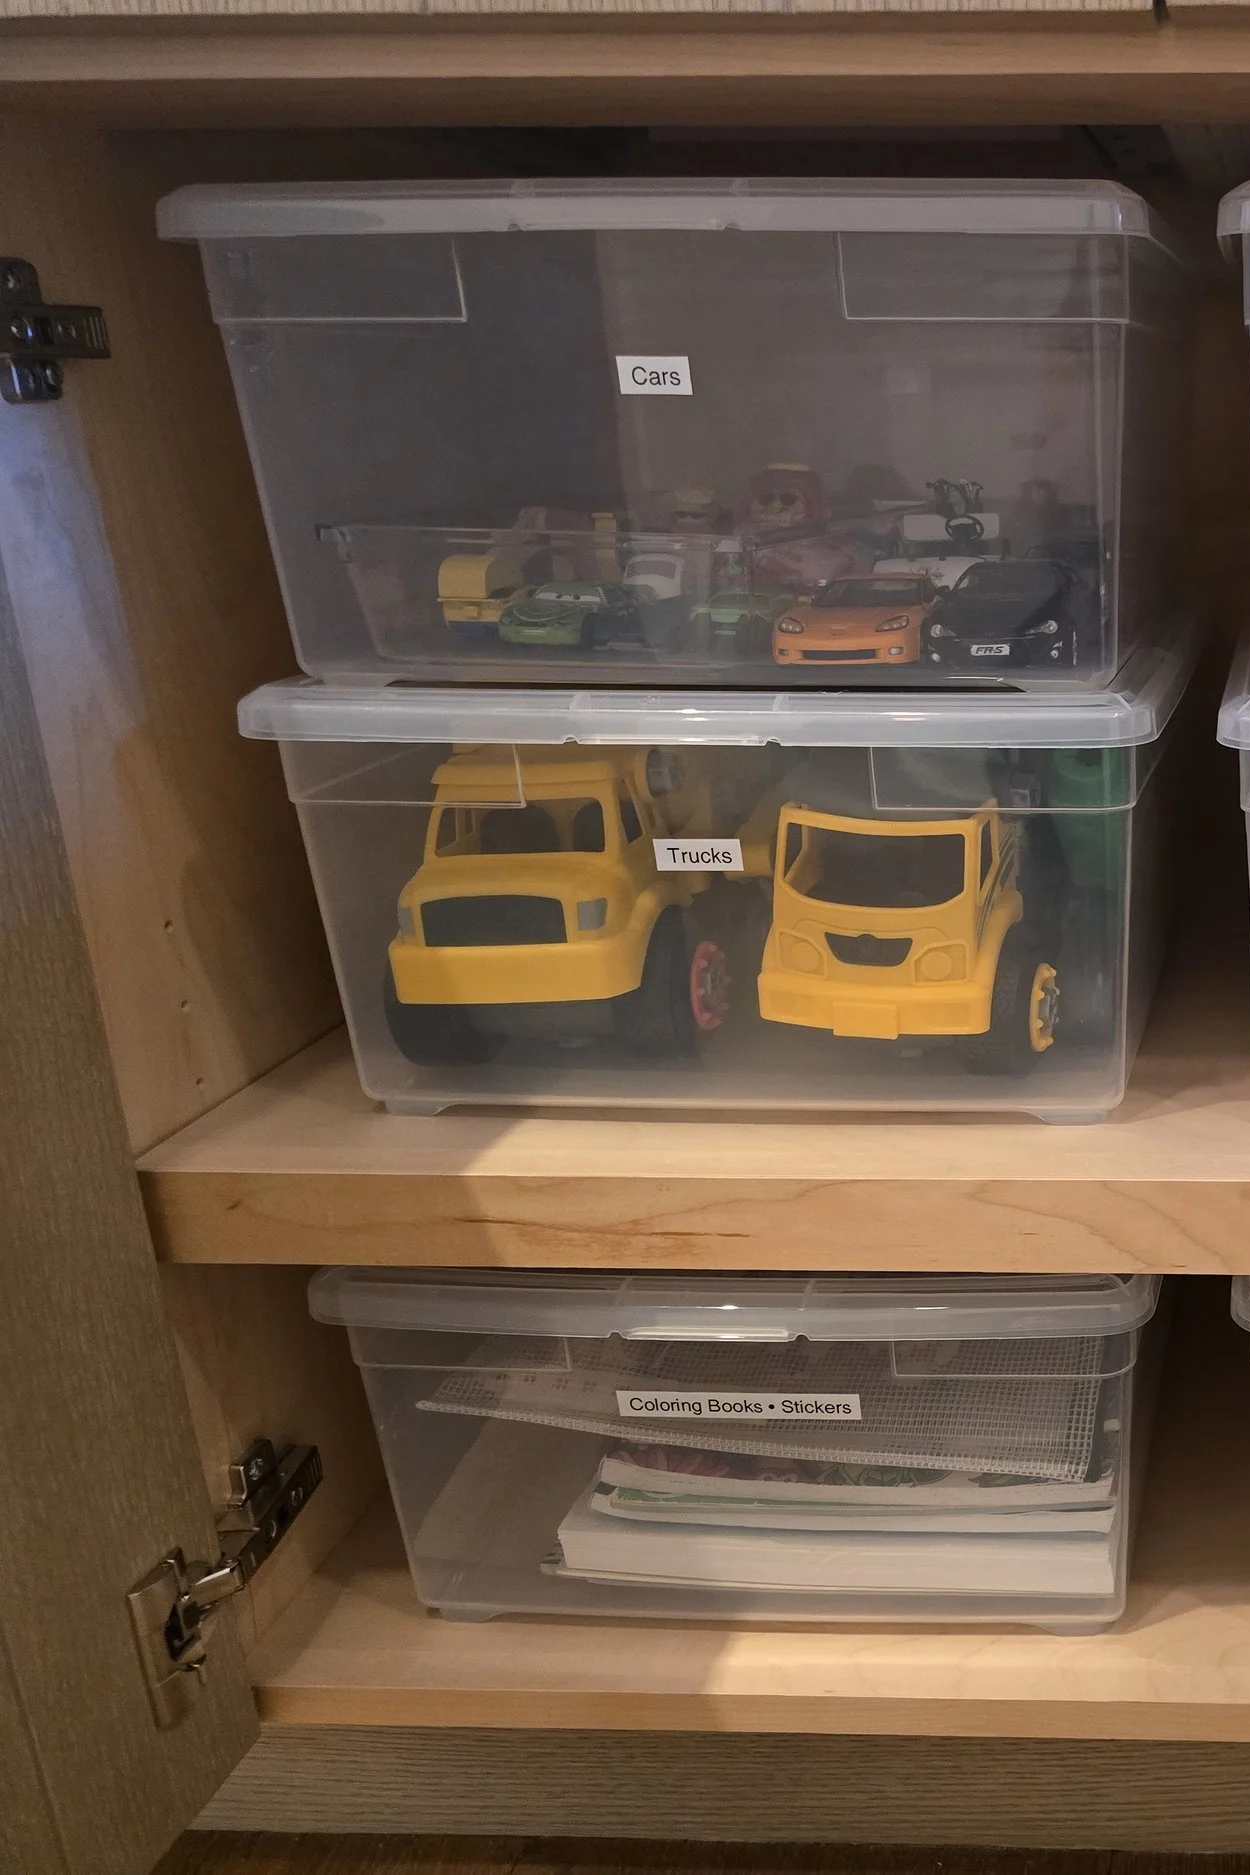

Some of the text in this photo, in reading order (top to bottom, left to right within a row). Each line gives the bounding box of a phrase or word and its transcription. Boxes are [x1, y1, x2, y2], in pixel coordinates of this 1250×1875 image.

[631, 366, 681, 386] Cars
[666, 847, 733, 864] Trucks
[629, 1397, 703, 1416] Coloring
[707, 1398, 763, 1413] Books
[781, 1399, 852, 1414] Stickers
